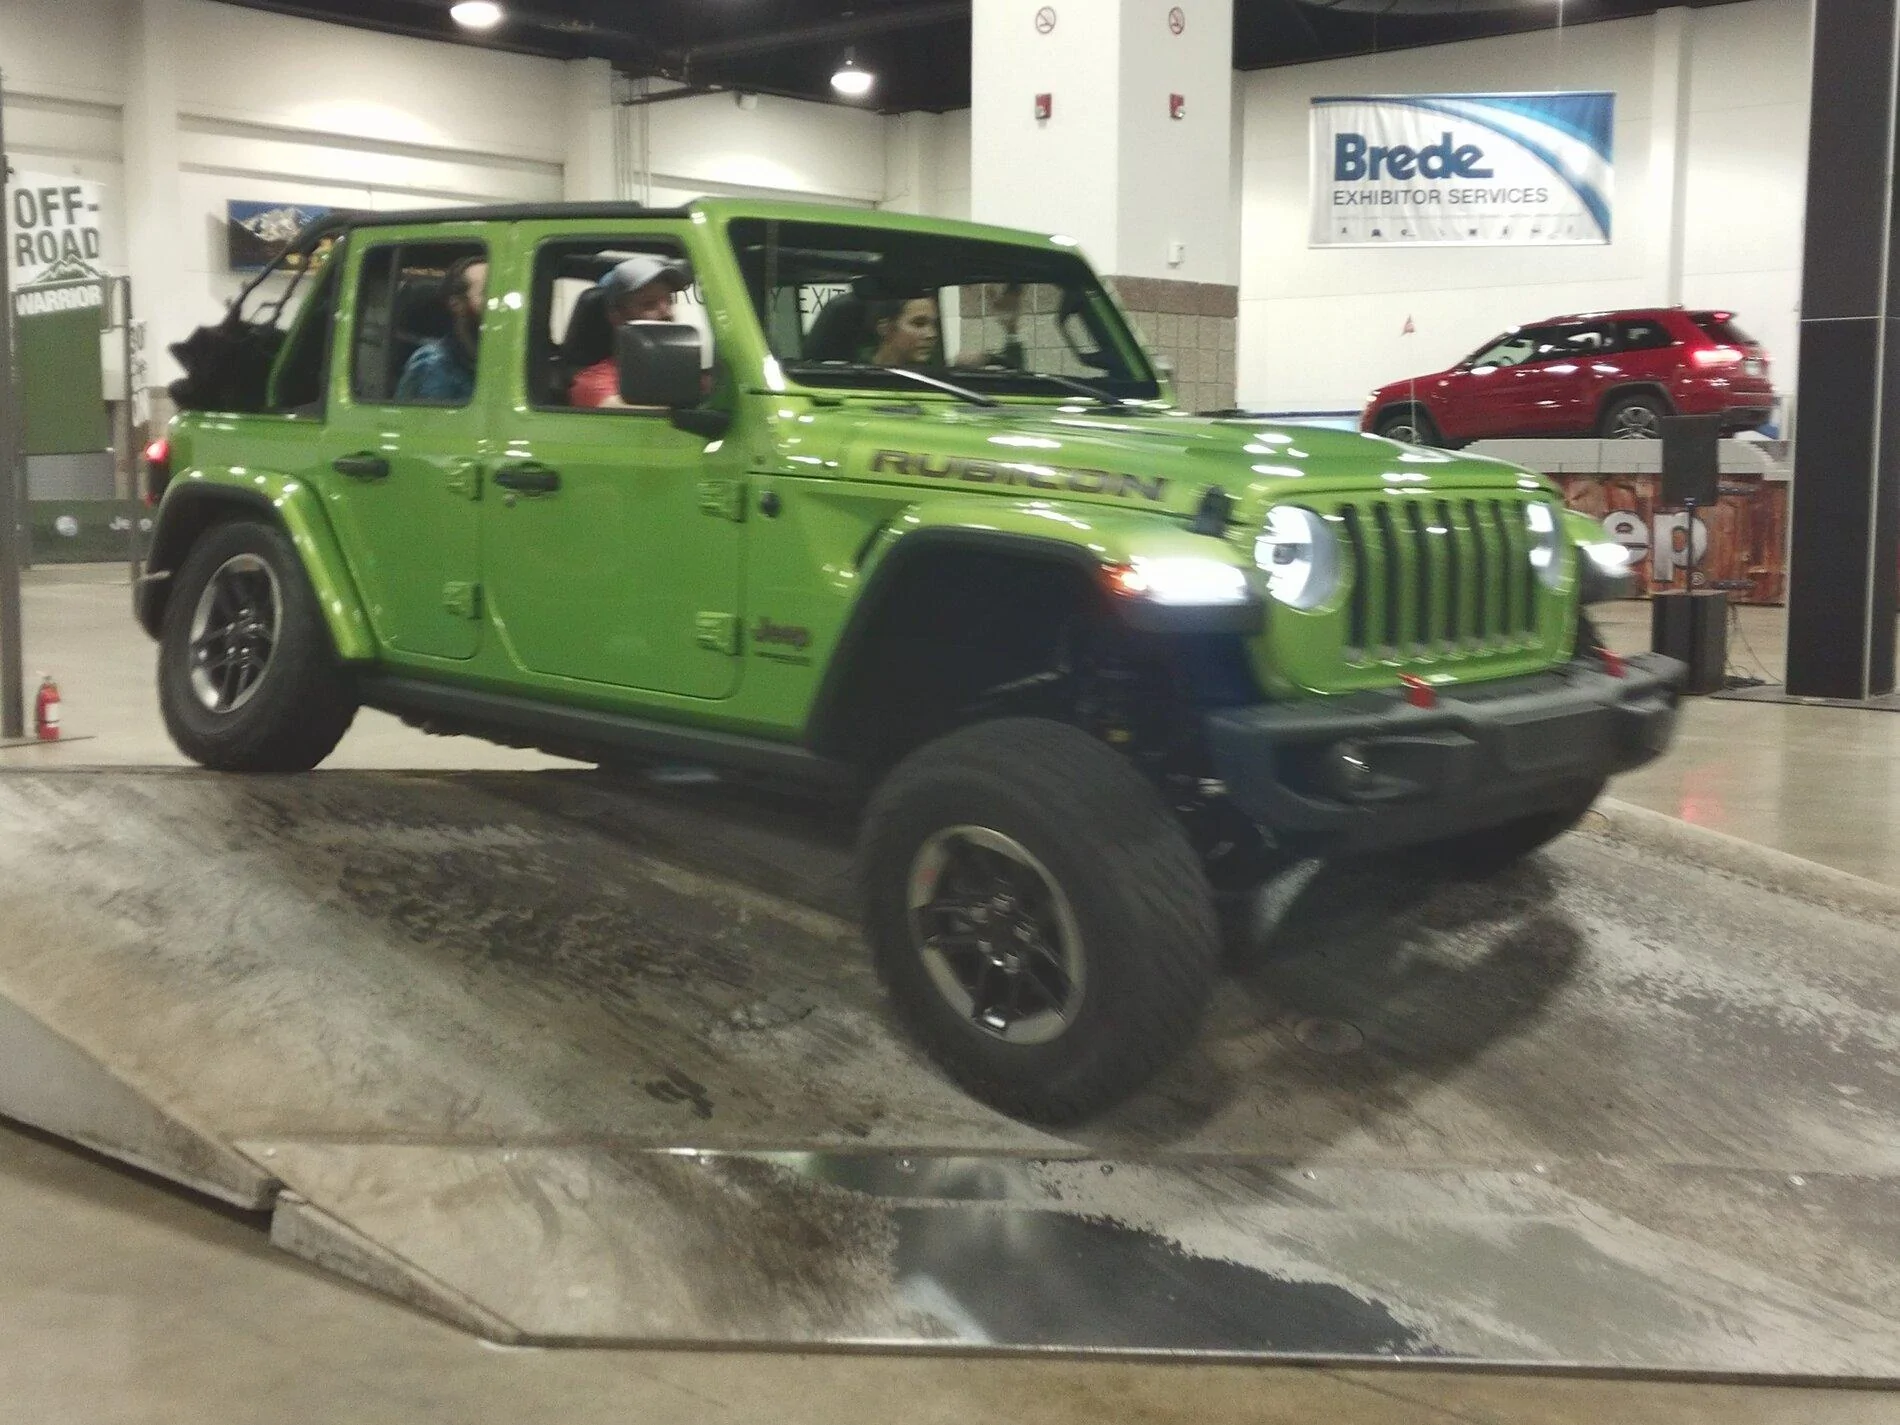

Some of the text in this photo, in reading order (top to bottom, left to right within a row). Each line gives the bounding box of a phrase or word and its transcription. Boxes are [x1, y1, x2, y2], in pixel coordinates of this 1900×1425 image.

[1334, 132, 1494, 181] Brede
[14, 186, 99, 228] OFF-
[1333, 187, 1549, 206] EXHIBITOR SERVICES
[15, 227, 100, 267] ROAD
[17, 285, 101, 316] WARRIOR
[870, 449, 1169, 500] RUBICON
[1602, 510, 1708, 582] ep
